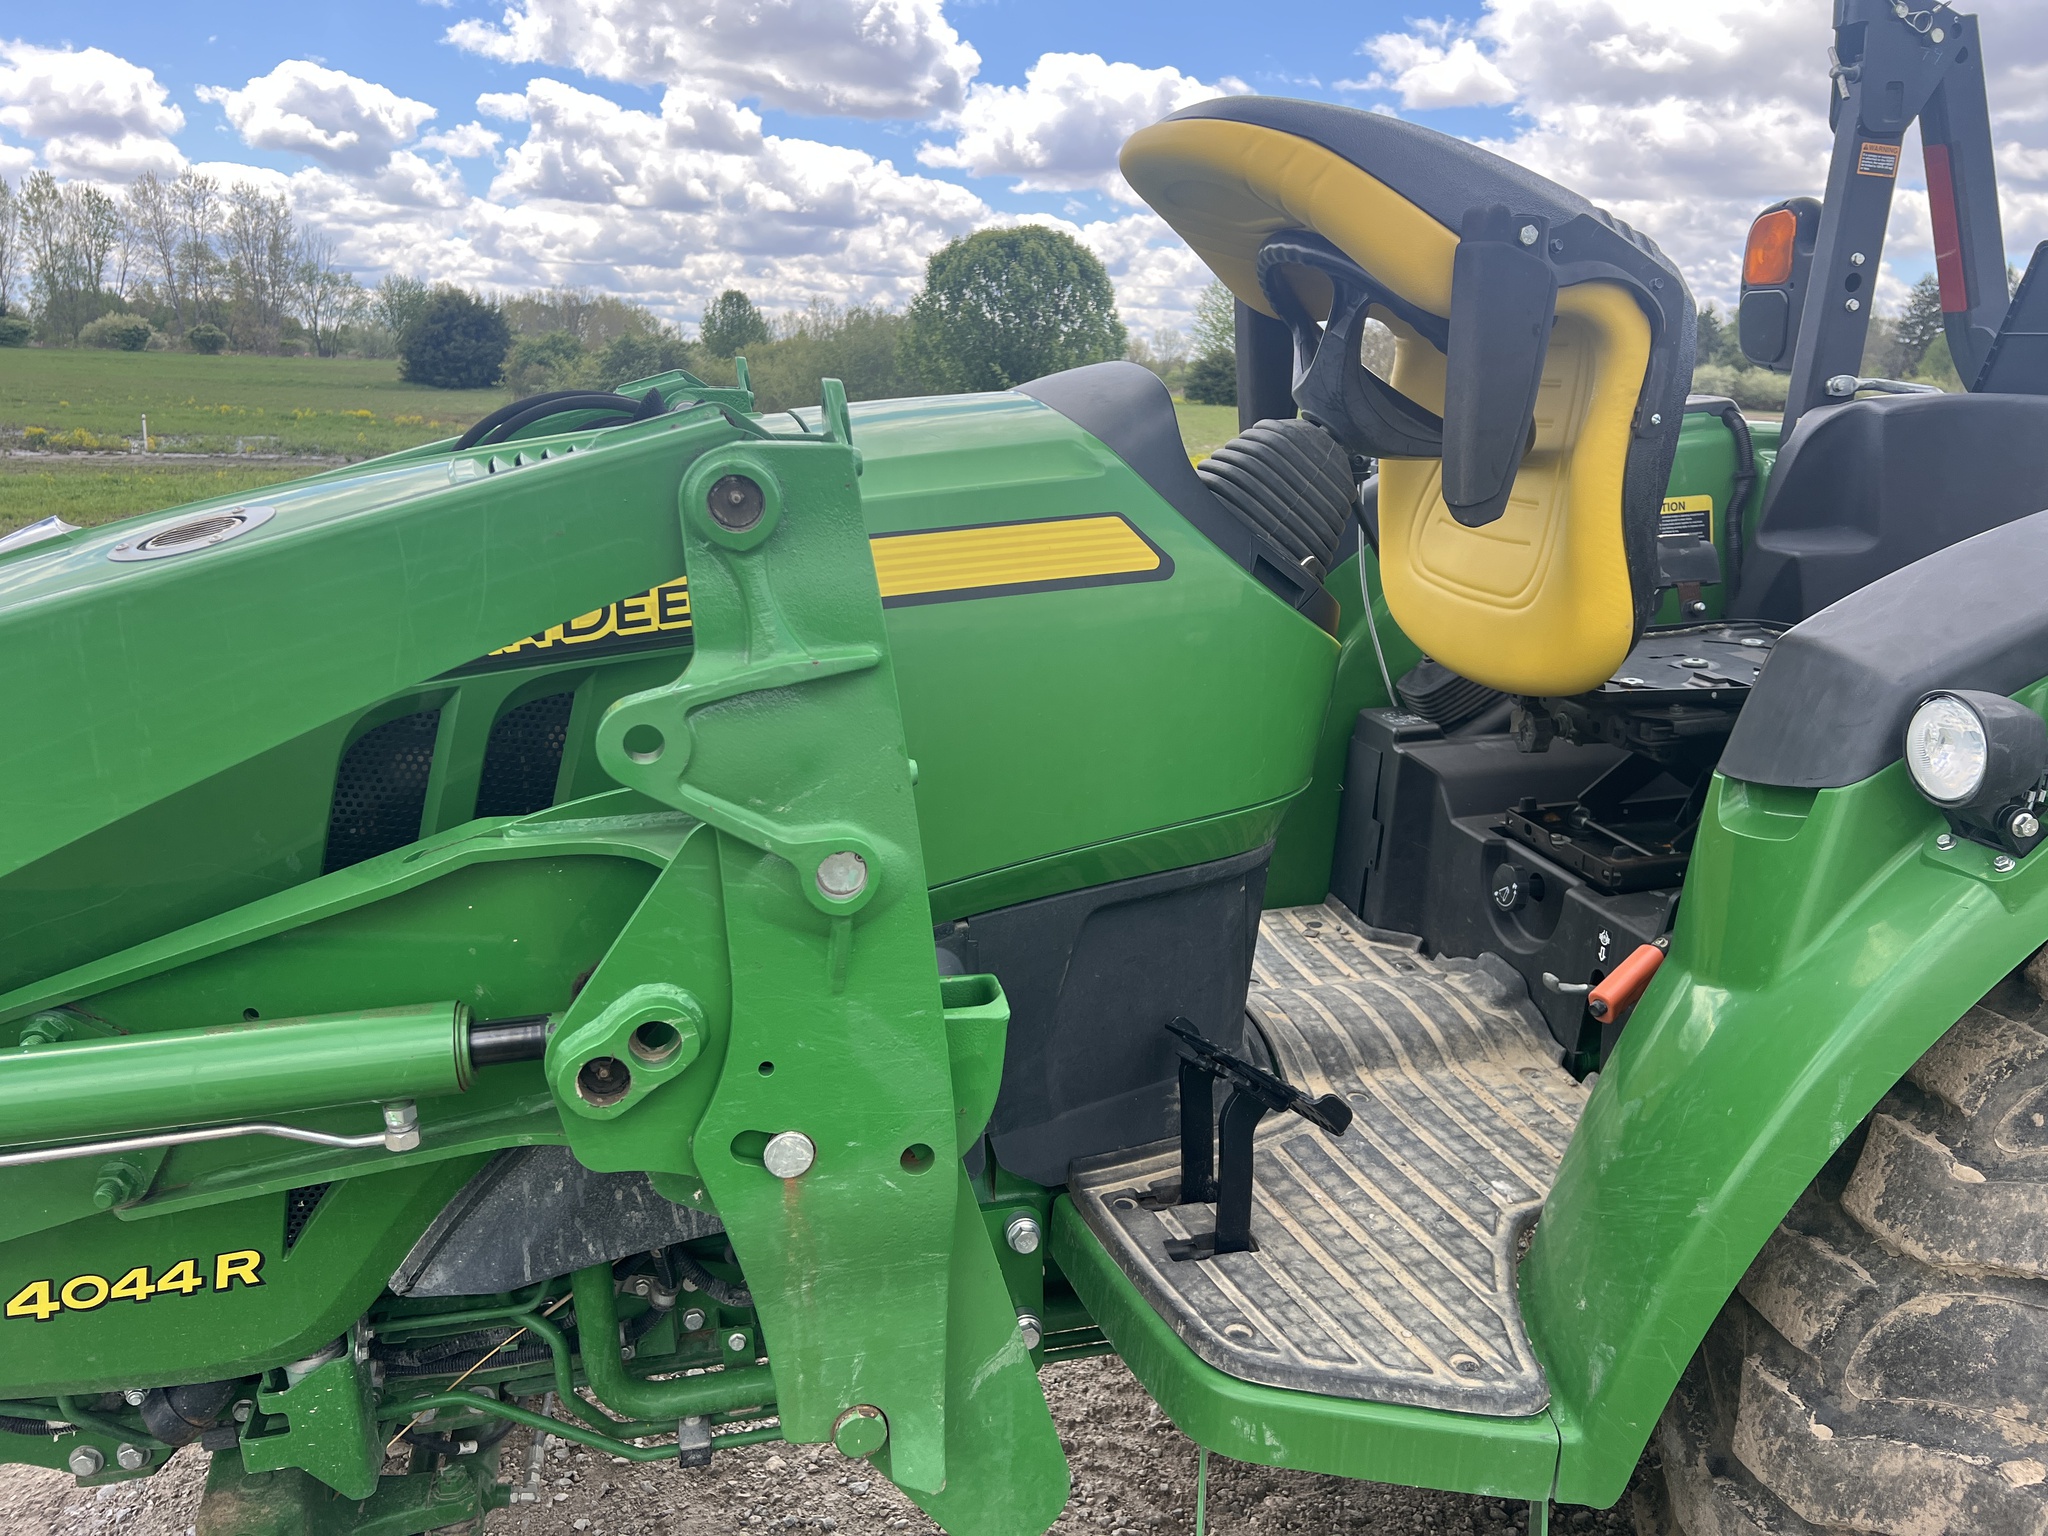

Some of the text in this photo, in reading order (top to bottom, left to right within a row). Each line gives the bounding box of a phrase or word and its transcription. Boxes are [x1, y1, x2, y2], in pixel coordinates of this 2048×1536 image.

[1869, 144, 1898, 154] WARNING
[1662, 501, 1686, 512] TION
[561, 578, 692, 643] DEE
